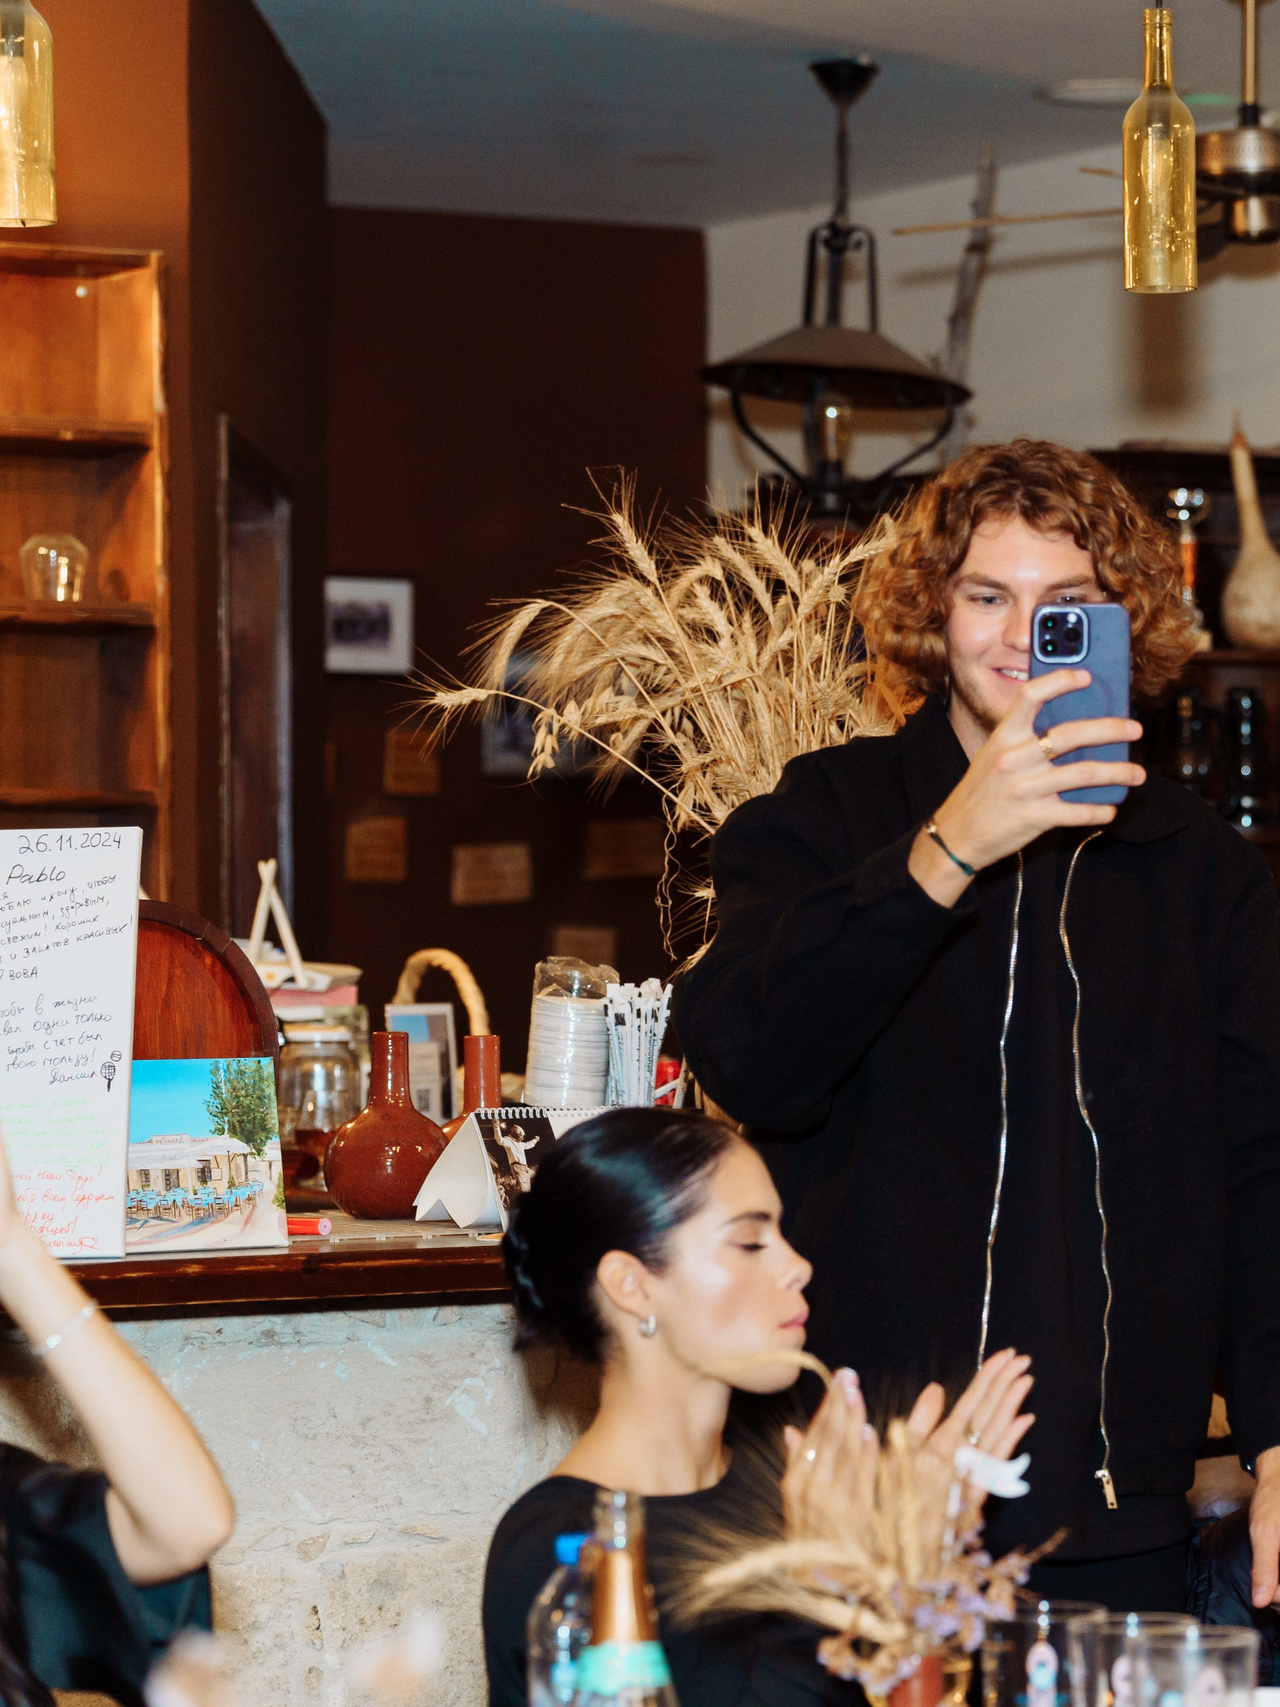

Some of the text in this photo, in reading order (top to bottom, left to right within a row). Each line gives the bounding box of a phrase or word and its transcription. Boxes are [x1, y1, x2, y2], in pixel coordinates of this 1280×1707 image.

[18, 832, 121, 855] 26.11.2024
[5, 863, 66, 885] Pablo
[0, 910, 55, 934] суальным,
[0, 1001, 26, 1018] тобы
